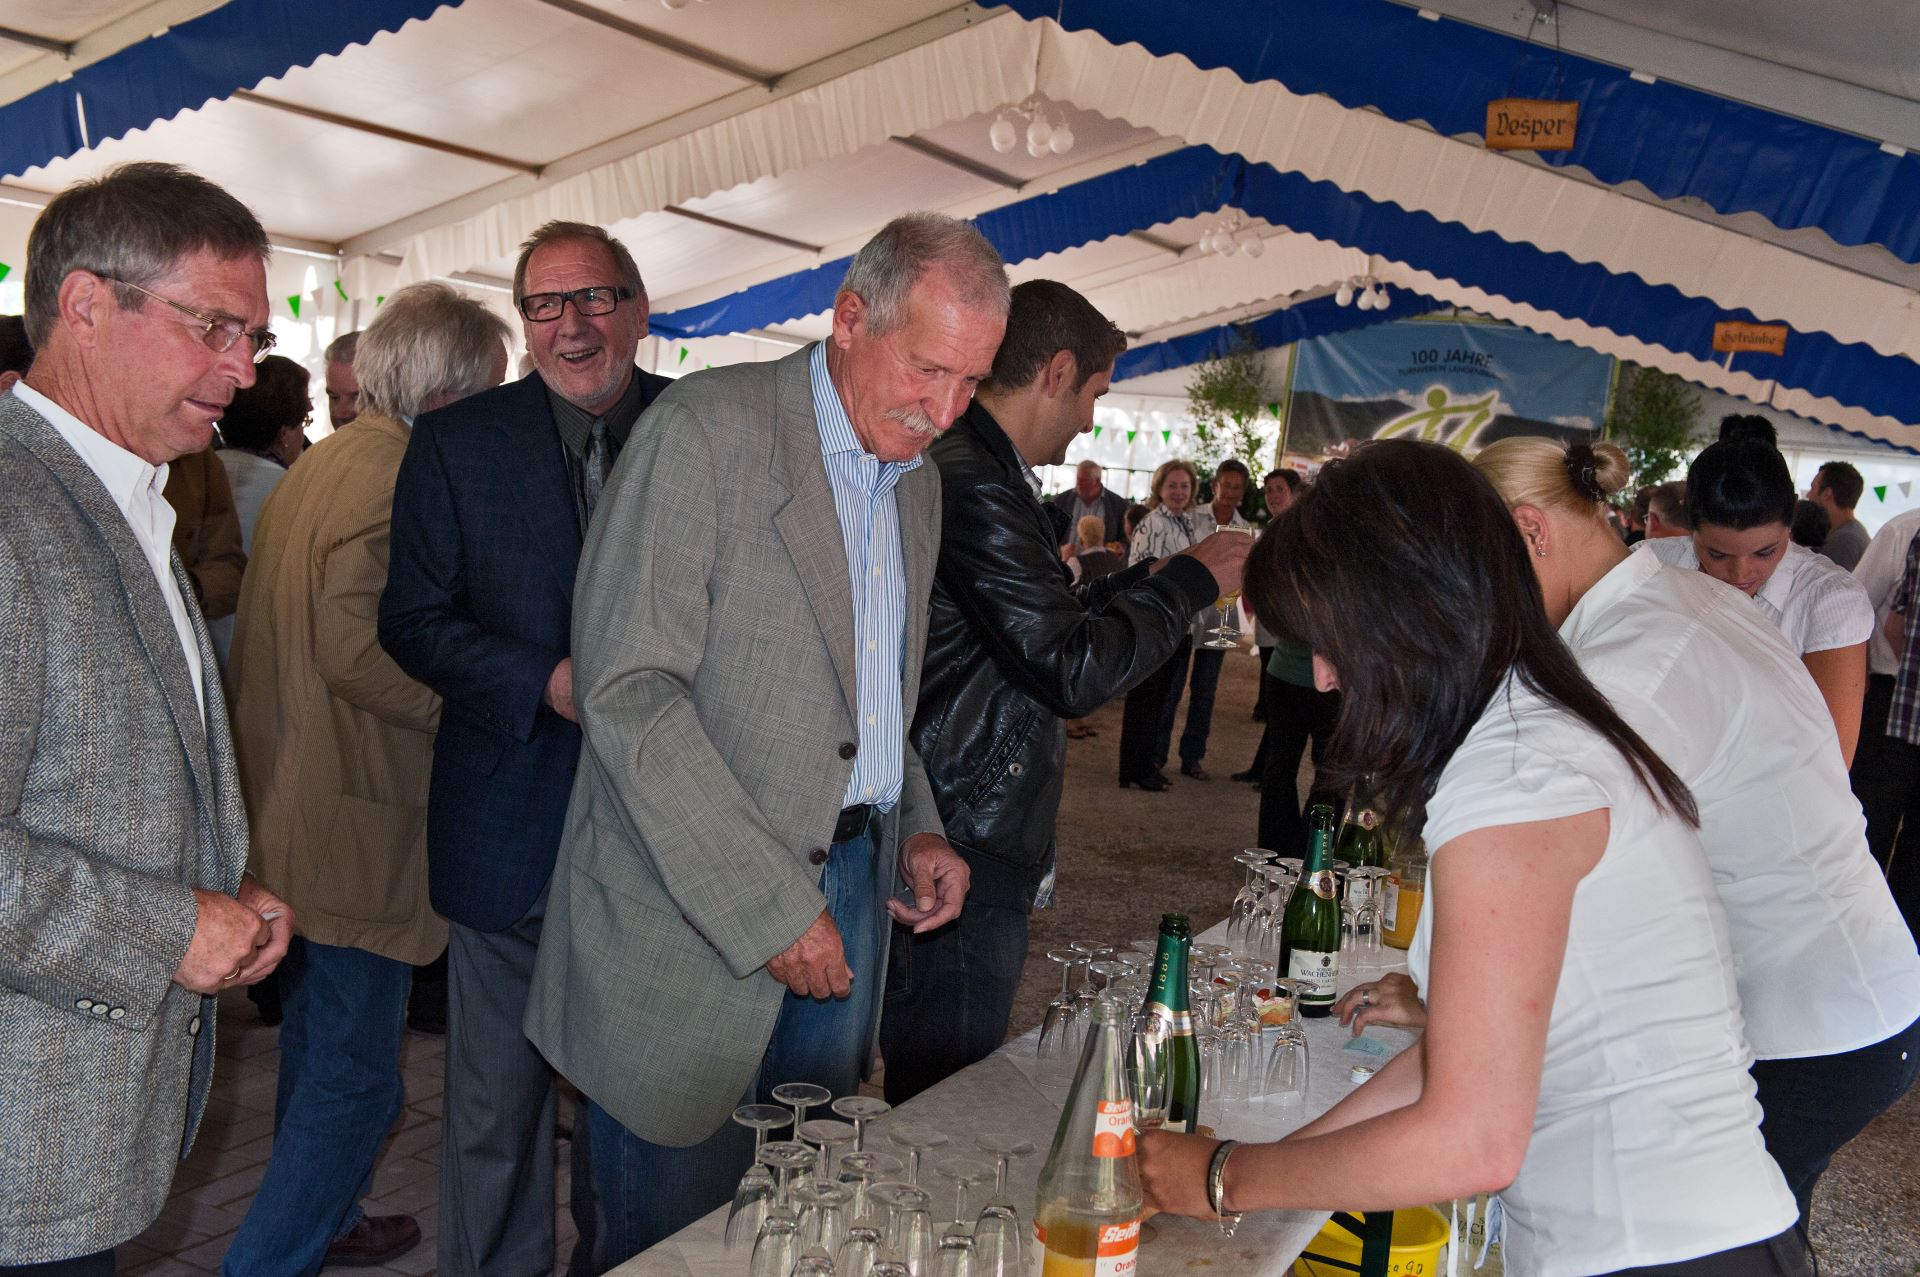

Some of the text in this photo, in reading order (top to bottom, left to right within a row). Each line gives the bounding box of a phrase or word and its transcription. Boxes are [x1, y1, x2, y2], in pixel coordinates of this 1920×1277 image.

[1495, 111, 1567, 142] Vesper
[1411, 348, 1494, 369] 100 JAHRE
[1157, 952, 1170, 990] 1888
